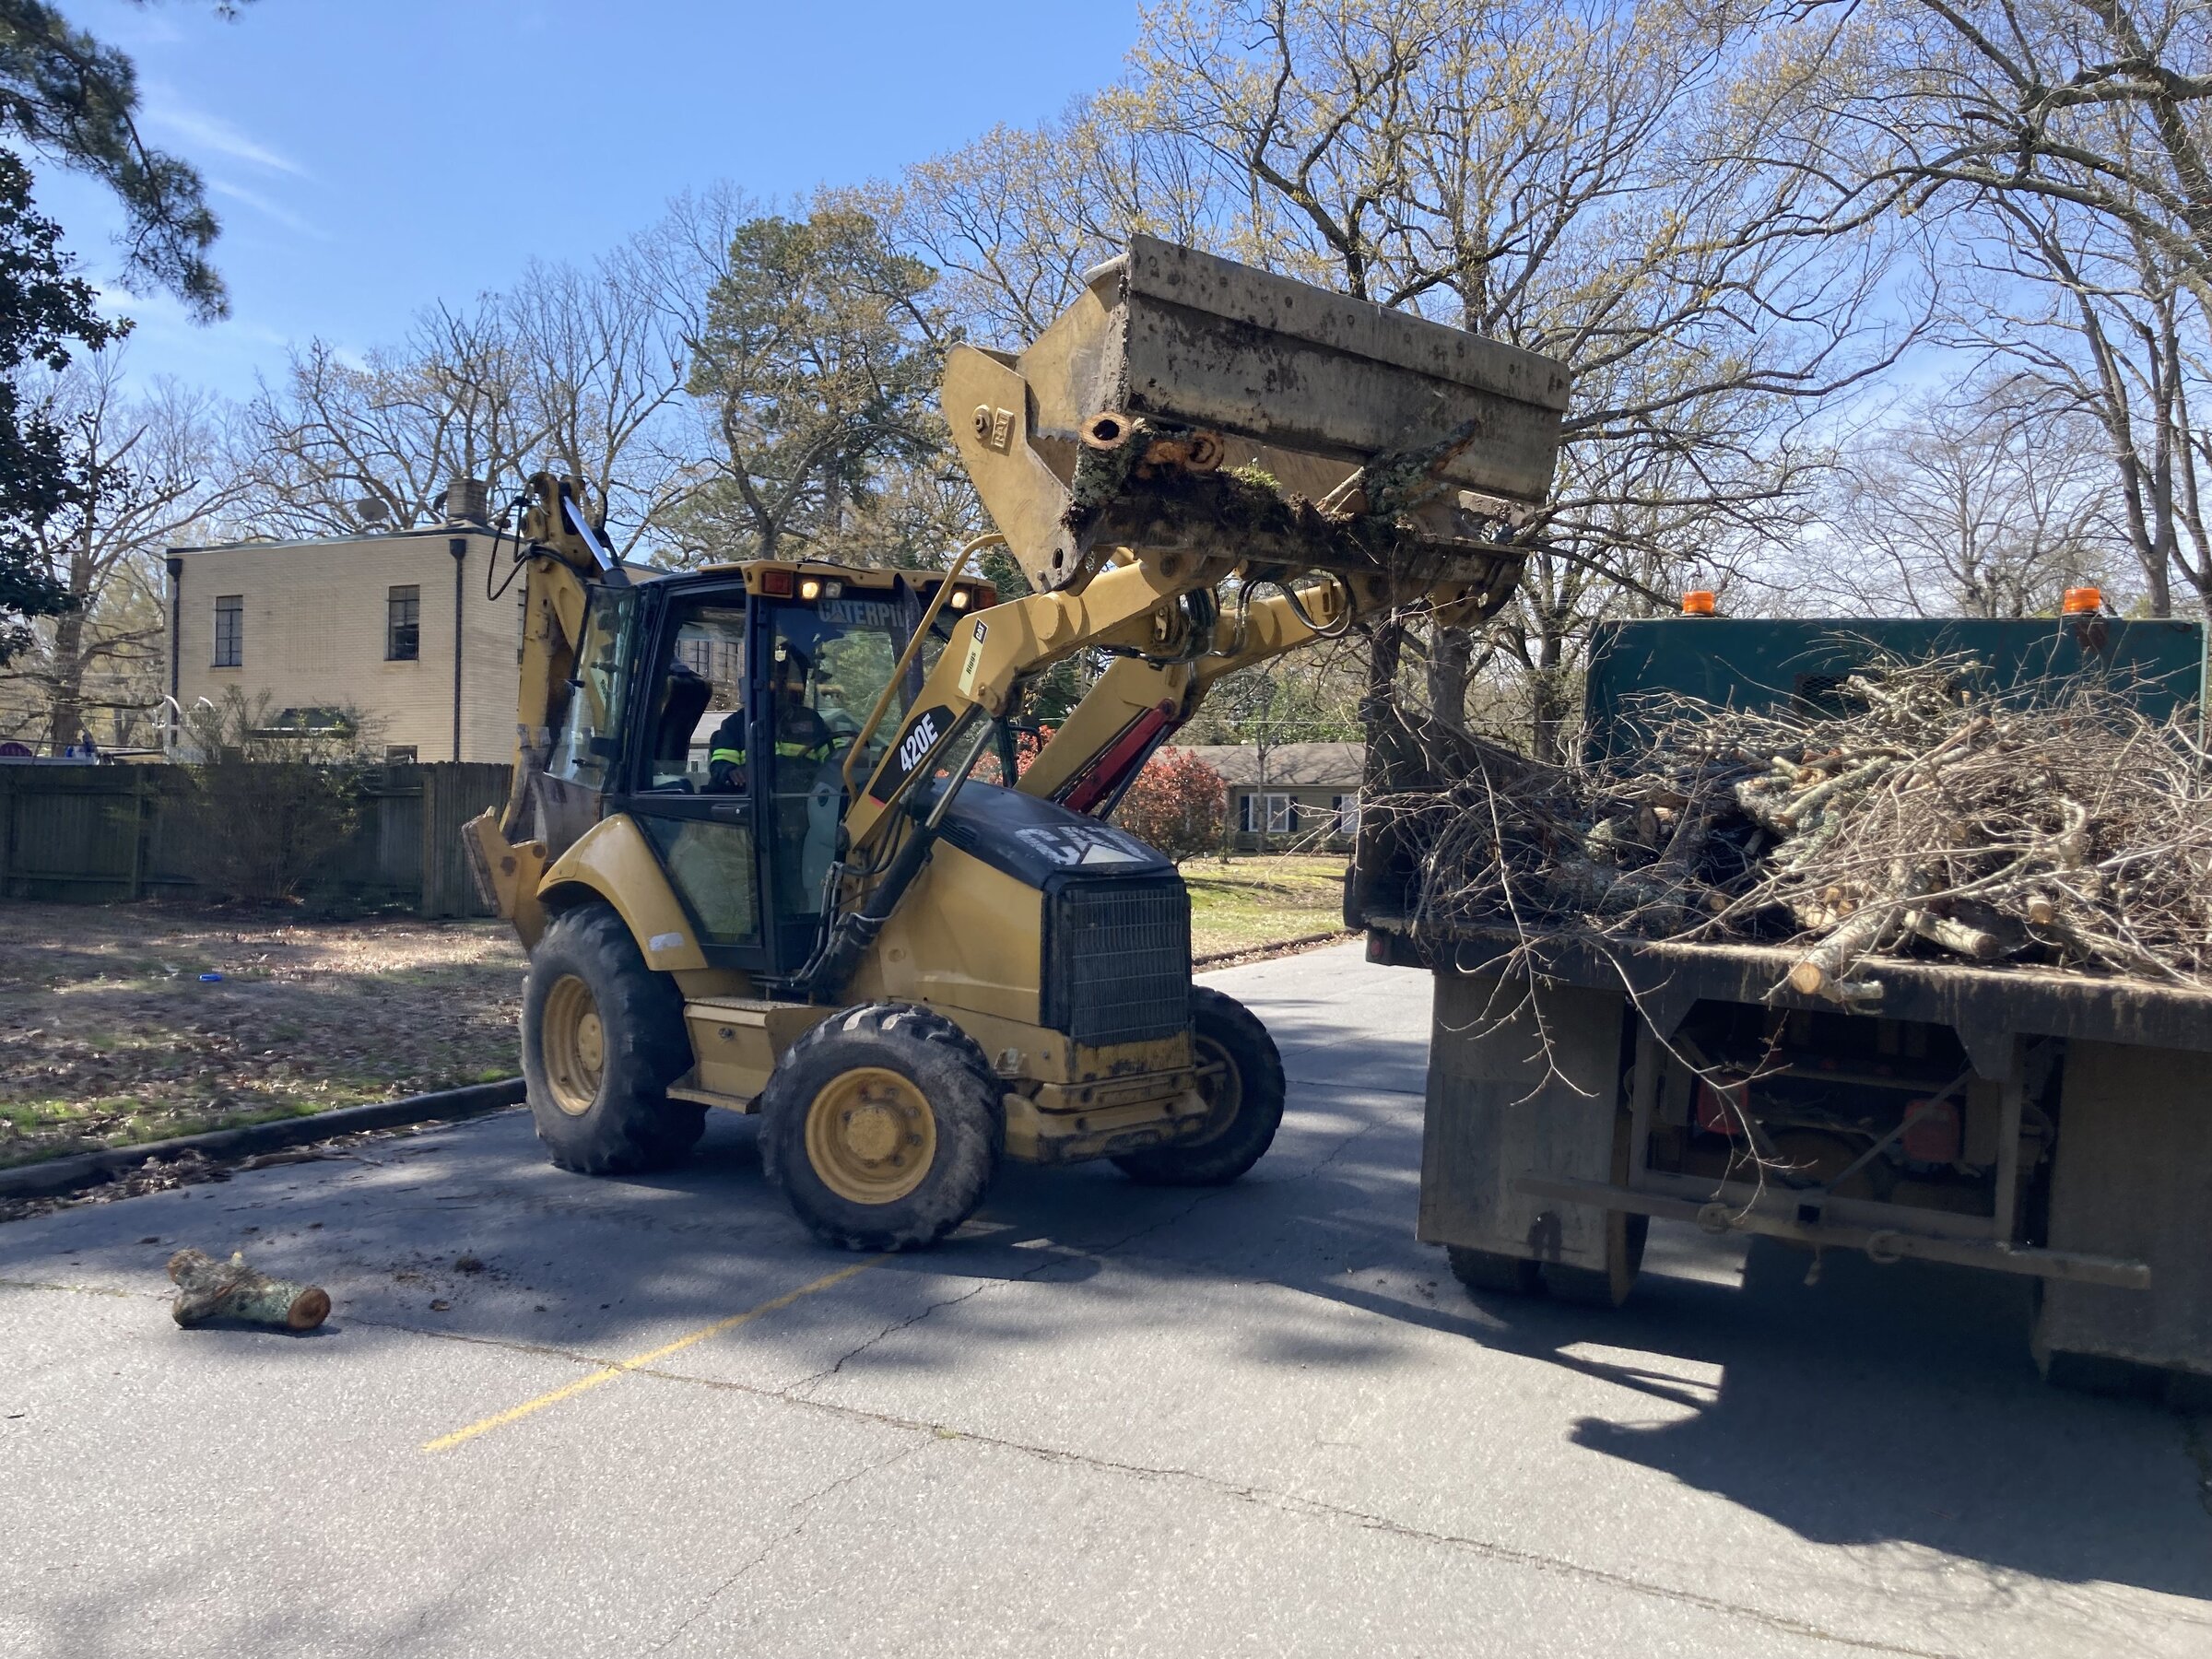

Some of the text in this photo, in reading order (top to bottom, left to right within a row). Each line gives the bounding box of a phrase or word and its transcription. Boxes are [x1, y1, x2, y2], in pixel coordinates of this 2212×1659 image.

[975, 622, 984, 641] CAT
[900, 712, 938, 771] 420E
[1014, 826, 1153, 865] CAT
